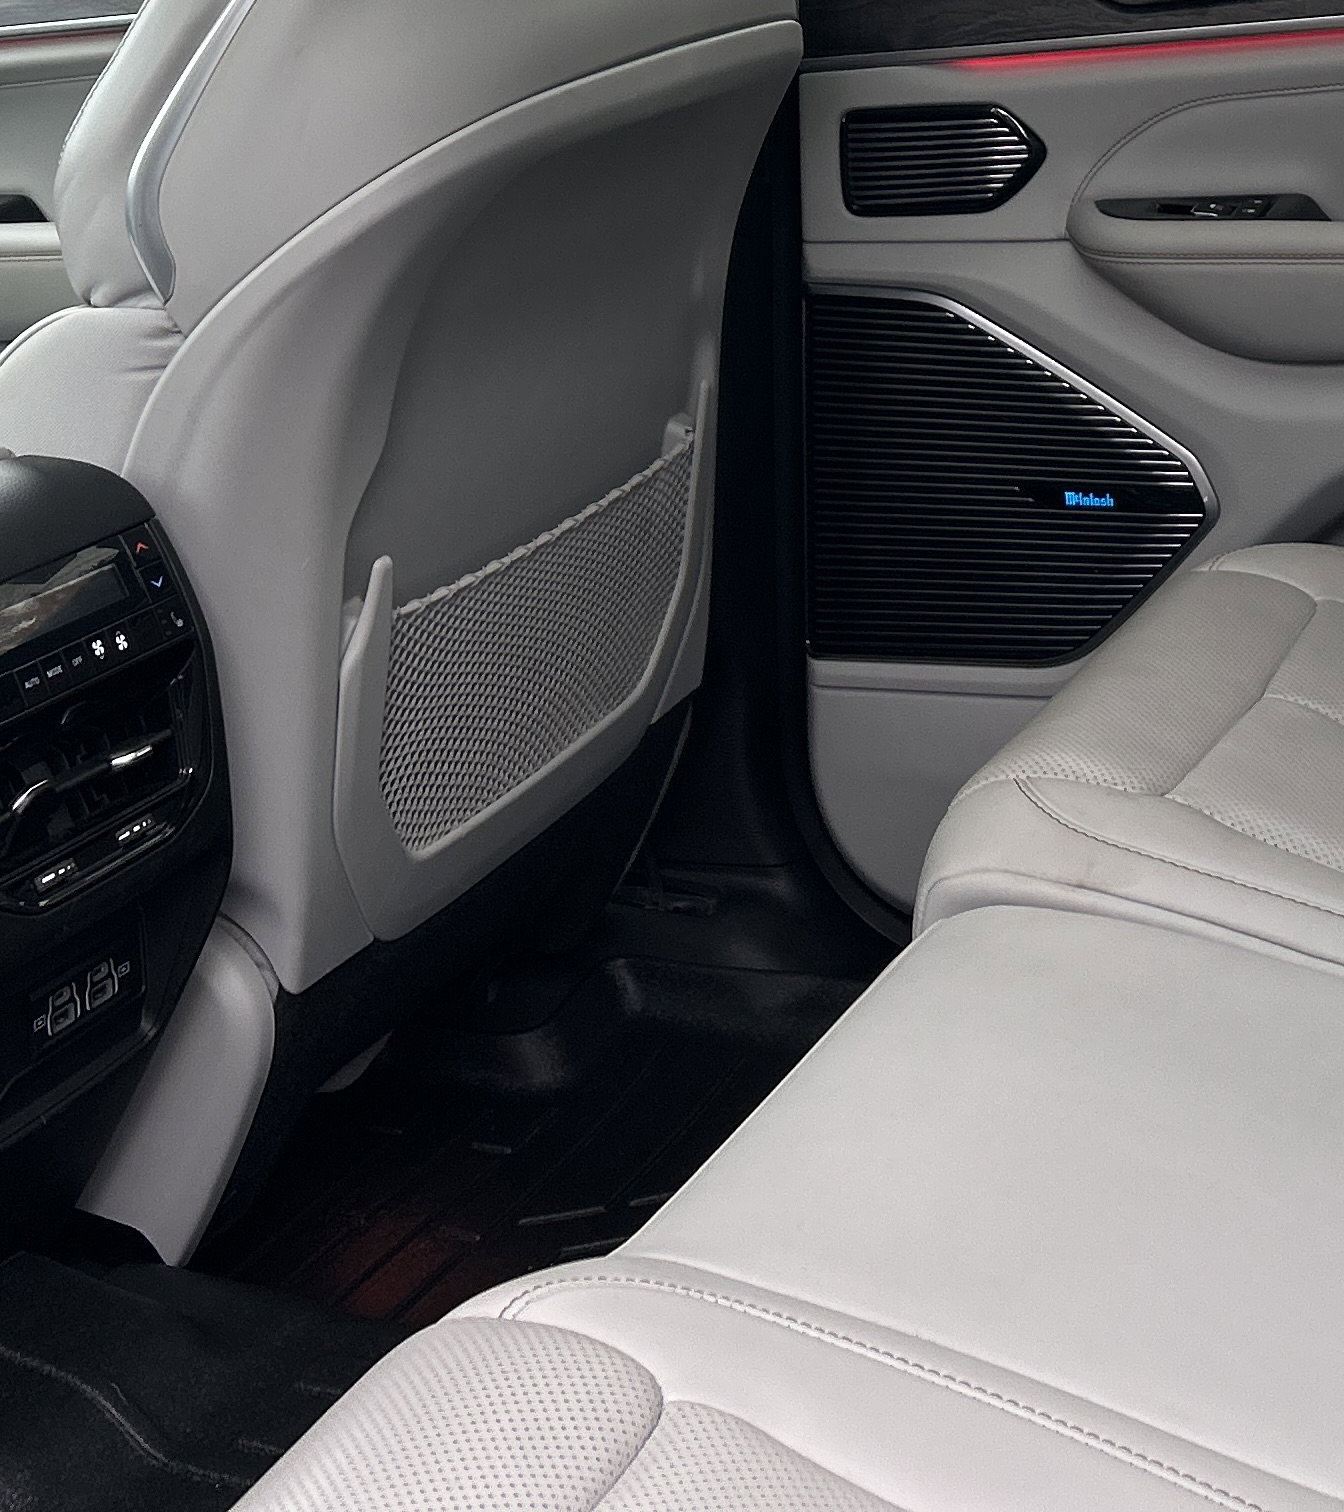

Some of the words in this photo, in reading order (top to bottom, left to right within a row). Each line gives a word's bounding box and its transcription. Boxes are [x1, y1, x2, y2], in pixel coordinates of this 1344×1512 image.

[1064, 491, 1115, 507] McIntosh
[24, 676, 40, 689] AUTO
[46, 664, 63, 678] MODE
